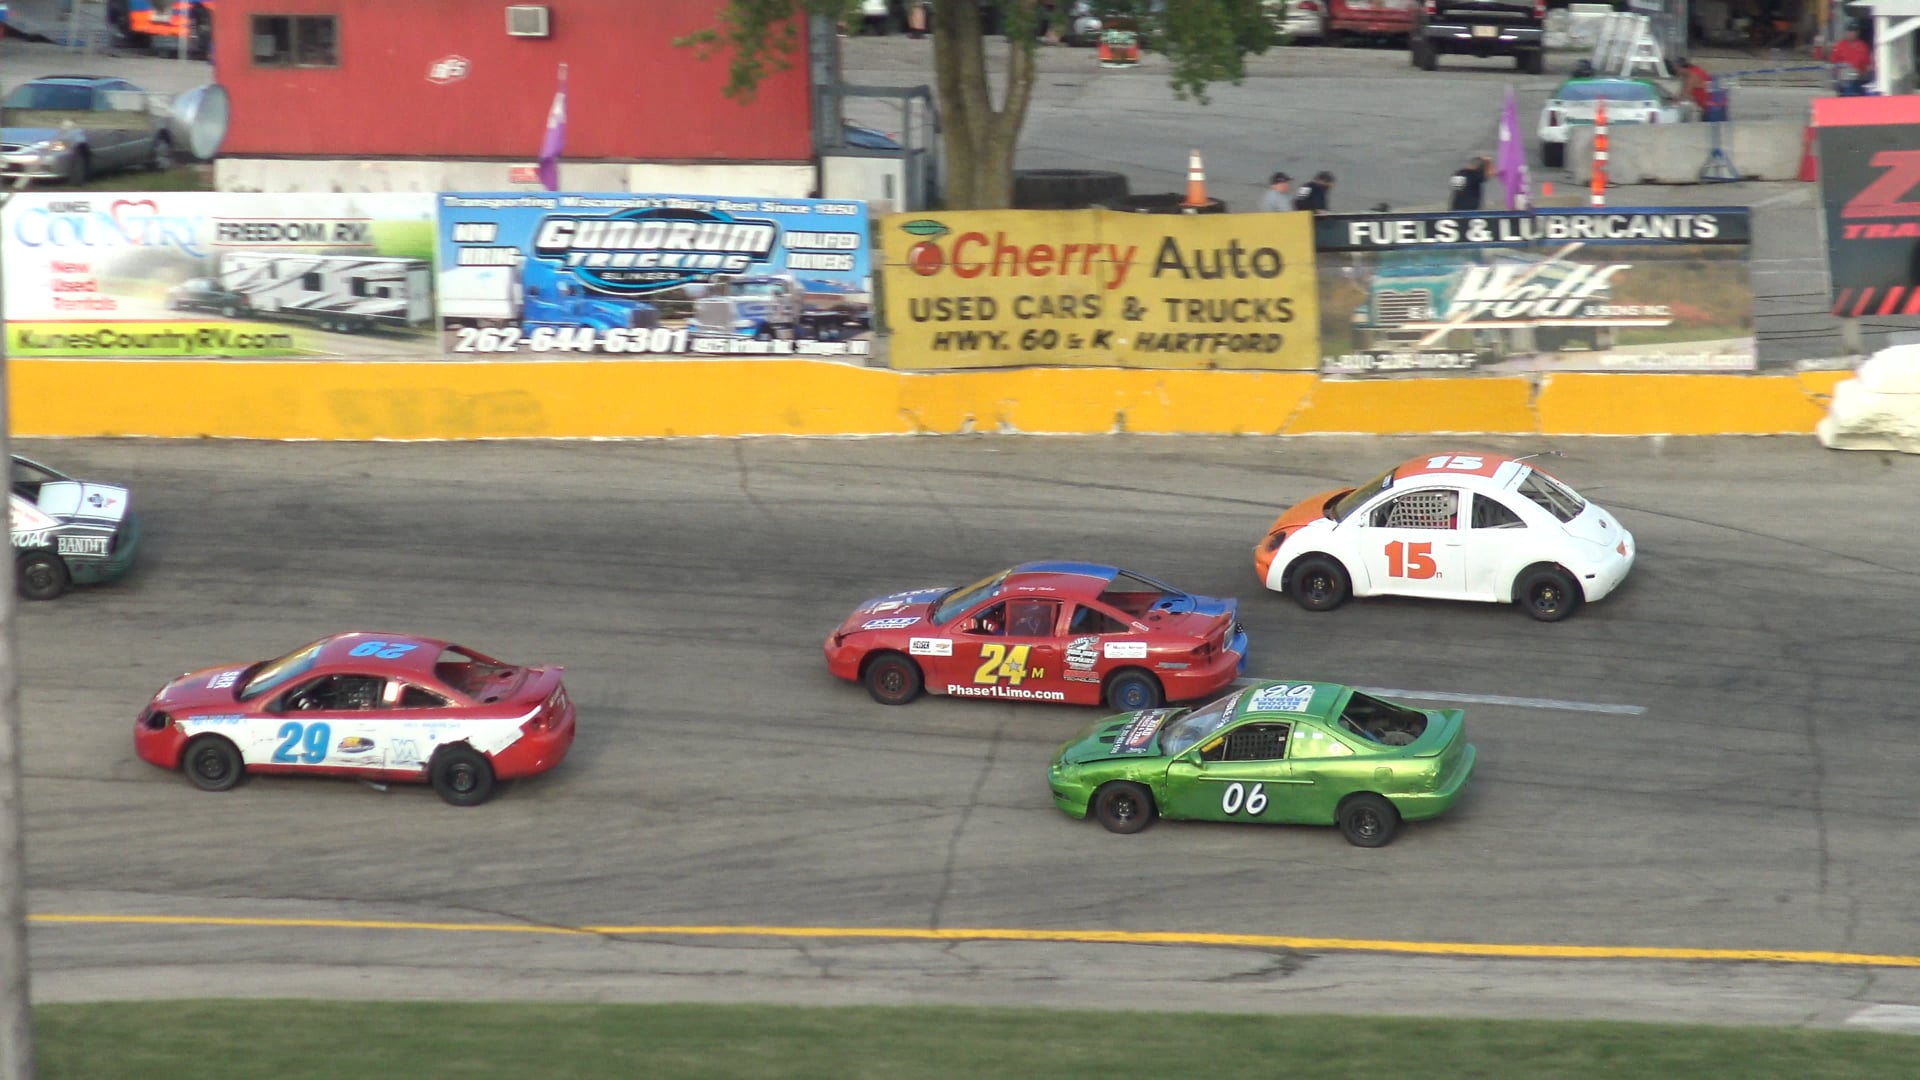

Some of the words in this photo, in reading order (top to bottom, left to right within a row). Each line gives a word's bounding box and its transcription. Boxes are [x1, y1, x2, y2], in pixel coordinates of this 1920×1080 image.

[760, 203, 809, 214] Since
[216, 222, 325, 243] FREEDOM
[333, 222, 370, 243] RV
[1347, 219, 1460, 246] FUELS
[1466, 218, 1494, 242] &
[1500, 213, 1720, 242] LUBRICANTS
[952, 231, 1138, 290] Cherry
[1152, 236, 1284, 280] Auto
[909, 296, 998, 323] USED
[1014, 294, 1100, 321] CARS
[1121, 297, 1149, 321] &
[1164, 297, 1295, 323] TRUCKS
[17, 328, 293, 353] KunesCountryRV.com
[455, 327, 687, 353] 262-644-6301
[932, 331, 1009, 352] HWY.
[1020, 329, 1060, 351] 60
[1091, 330, 1114, 351] K
[1133, 331, 1285, 354] HARTFORD
[1425, 454, 1485, 470] 15
[1384, 540, 1437, 580] 15
[348, 640, 419, 660] 29
[974, 642, 1032, 686] 24
[1031, 666, 1045, 680] M
[947, 684, 1065, 701] Phase1Limo.com
[270, 720, 332, 765] 29
[1222, 782, 1269, 816] 06
